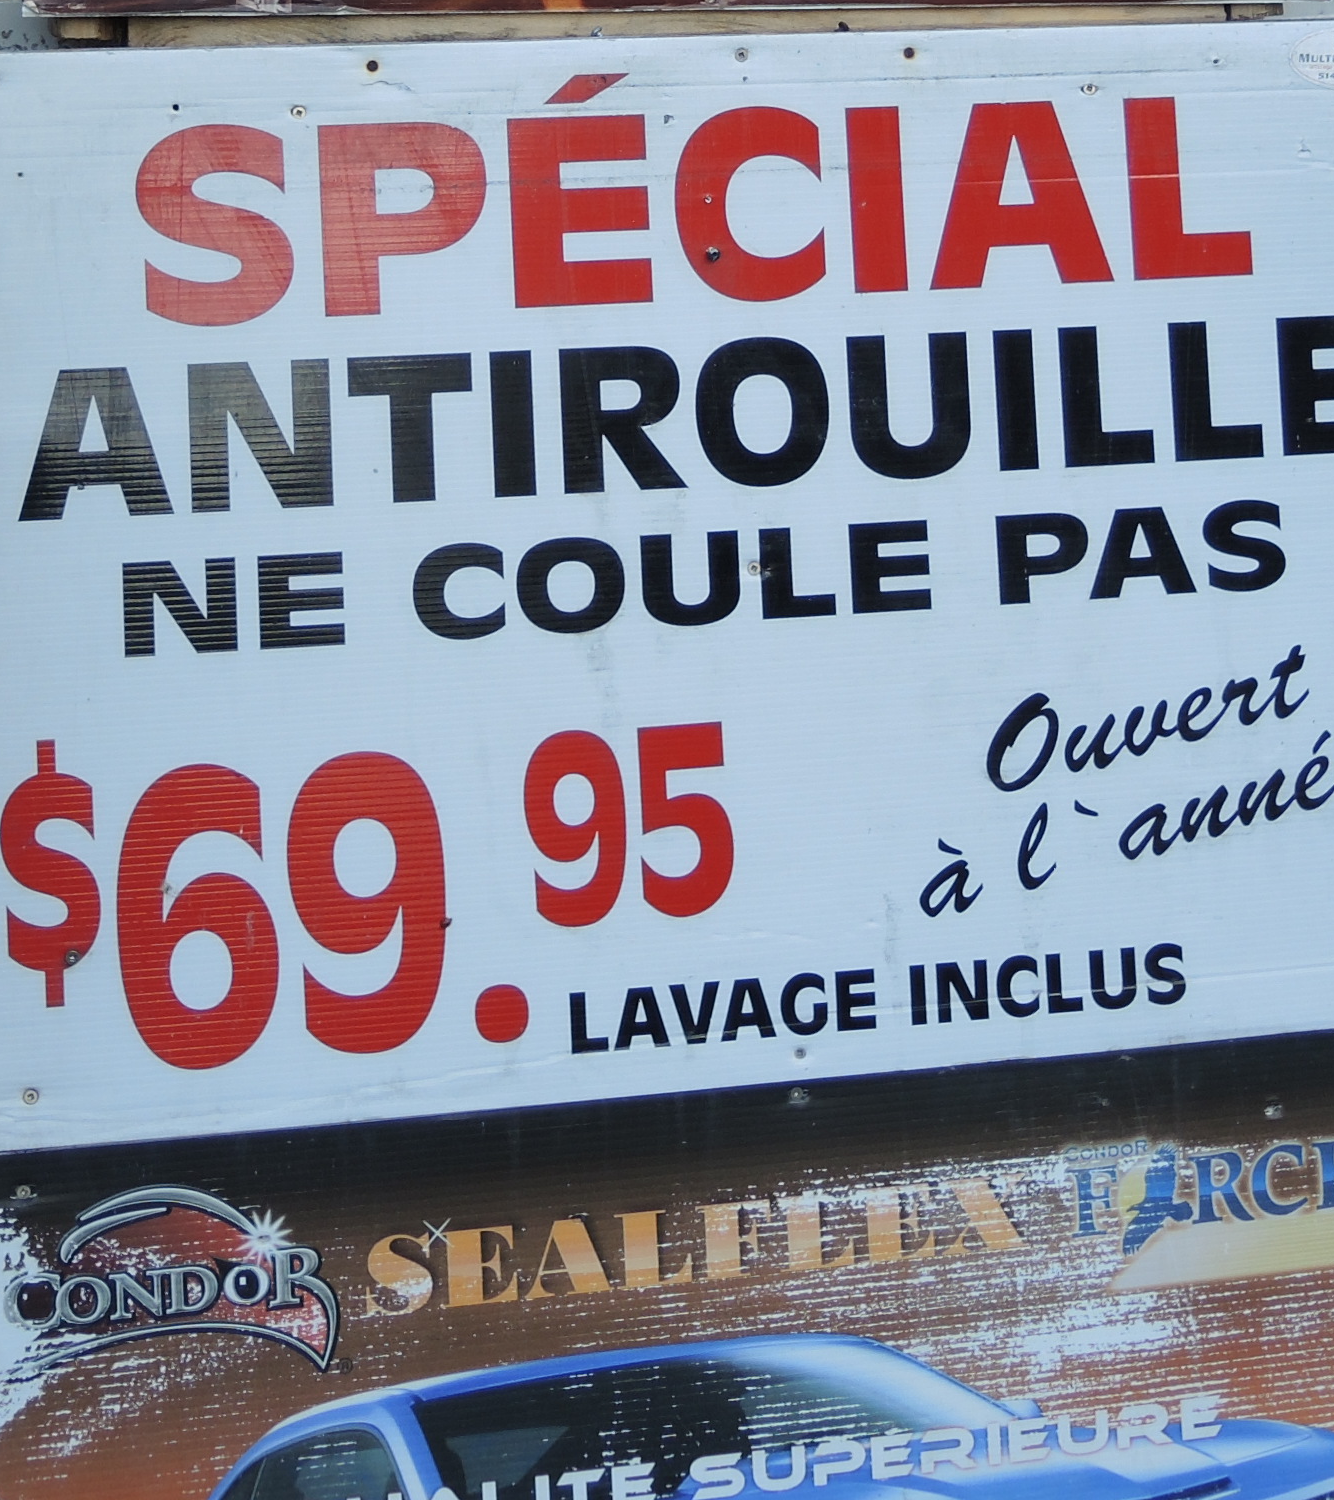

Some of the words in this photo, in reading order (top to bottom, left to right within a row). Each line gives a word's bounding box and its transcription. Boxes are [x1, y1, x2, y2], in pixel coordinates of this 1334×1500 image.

[134, 71, 1254, 328] SPÉCIAL
[122, 550, 347, 658] NE
[412, 519, 933, 641] COULE
[995, 499, 1287, 606] PAS
[985, 644, 1310, 793] Ouvert
[918, 837, 984, 919] à
[568, 969, 878, 1055] LAVAGE
[908, 942, 1187, 1027] INCLUS
[3, 1245, 325, 1331] CONDOR
[363, 1176, 1029, 1318] SEALFLEX
